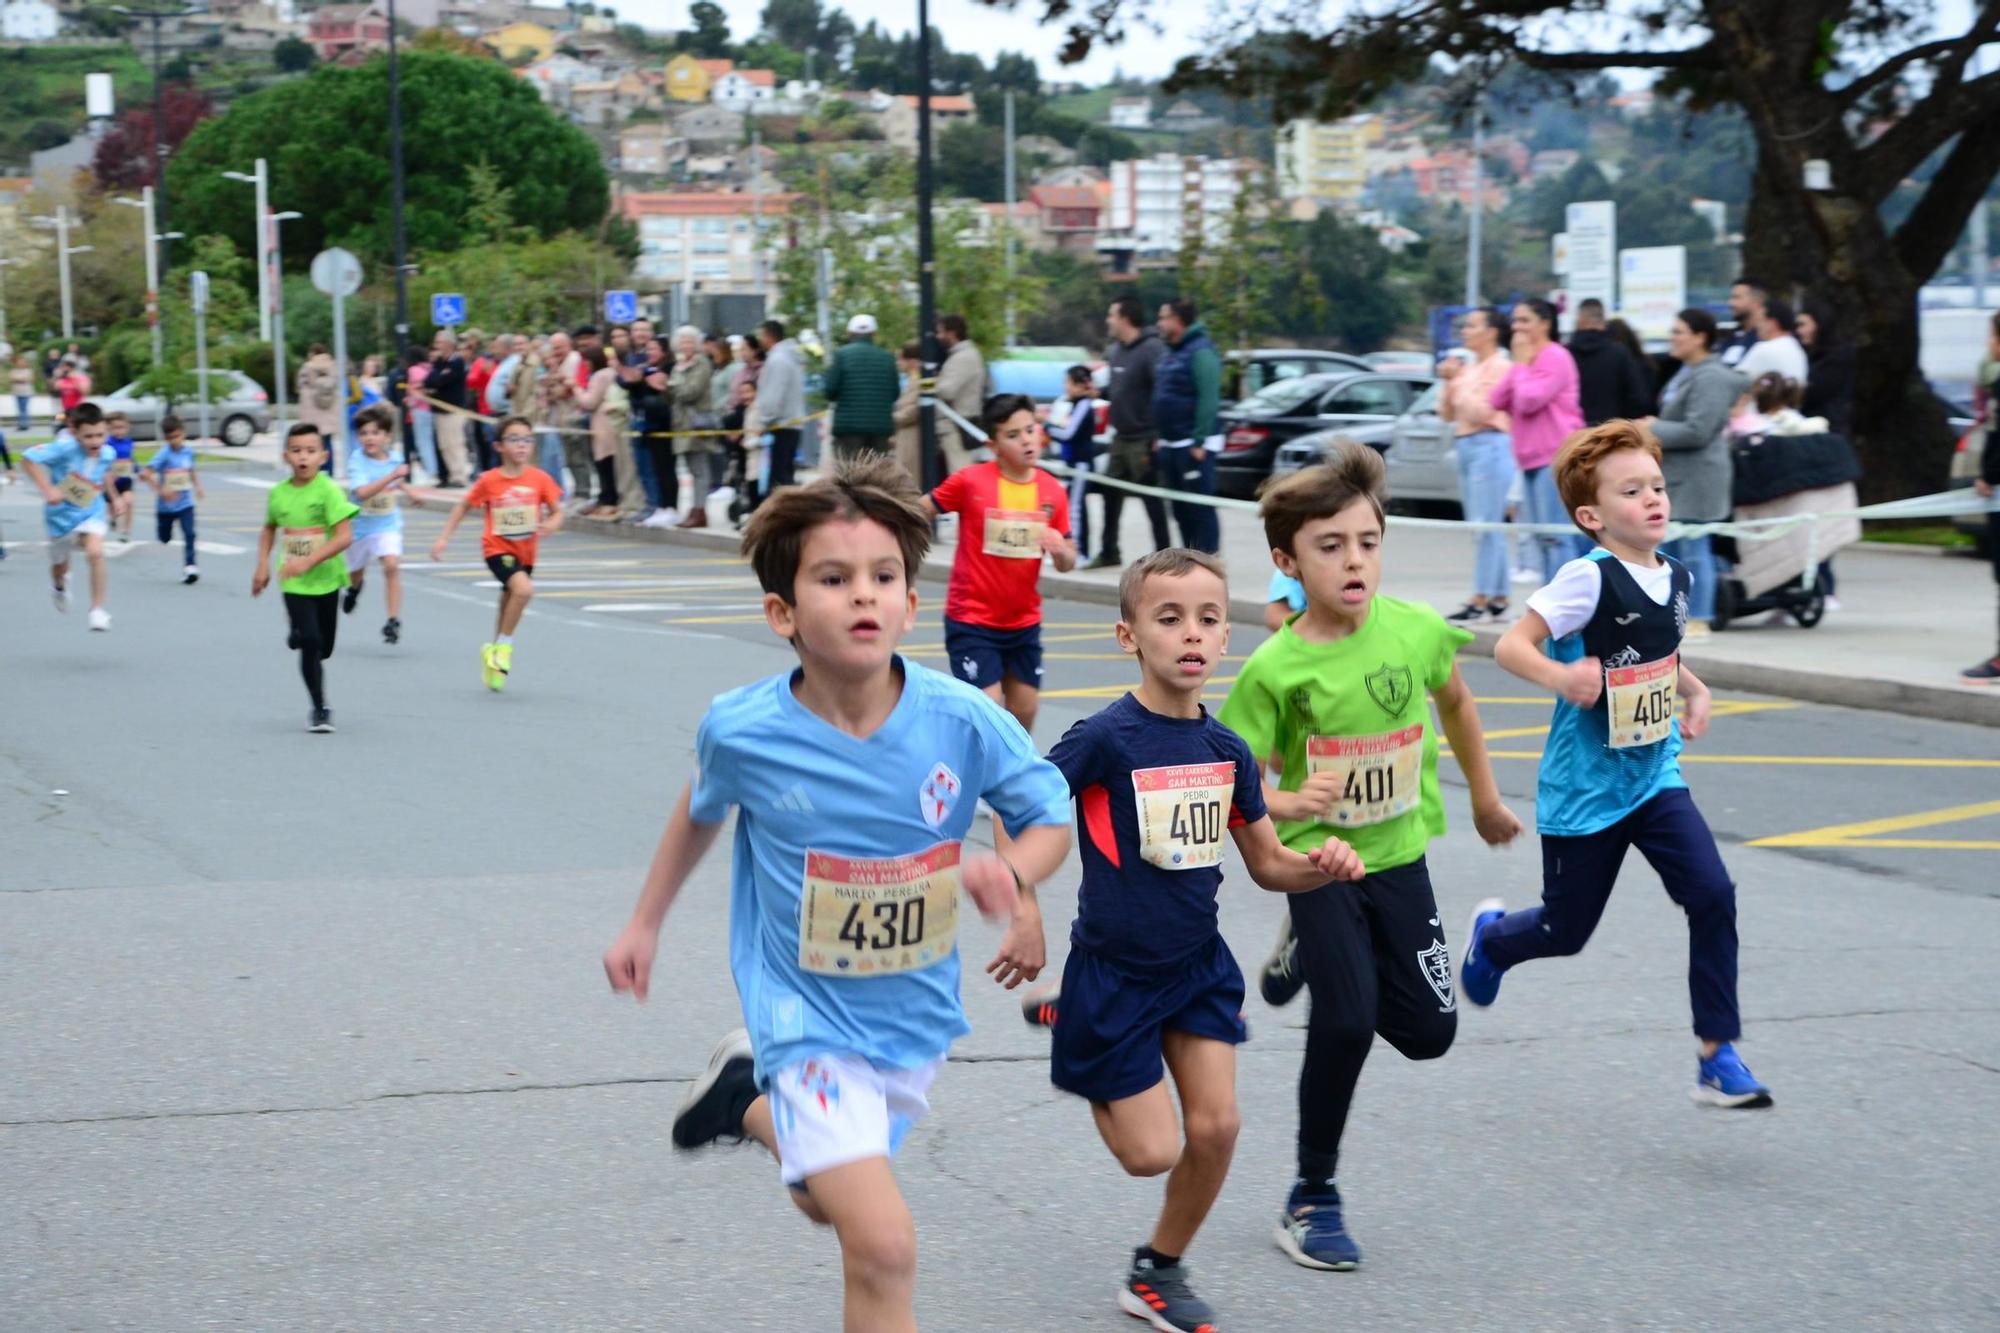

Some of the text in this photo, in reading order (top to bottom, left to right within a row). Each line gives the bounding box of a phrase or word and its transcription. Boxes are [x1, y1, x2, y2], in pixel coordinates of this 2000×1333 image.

[1633, 685, 1672, 727] 405
[1168, 778, 1187, 788] SAN
[1183, 791, 1209, 801] PEDRO
[1343, 764, 1393, 805] 401
[1170, 801, 1220, 845] 400
[849, 870, 876, 884] SAN
[884, 879, 931, 898] PEREIRA
[839, 896, 925, 950] 430
